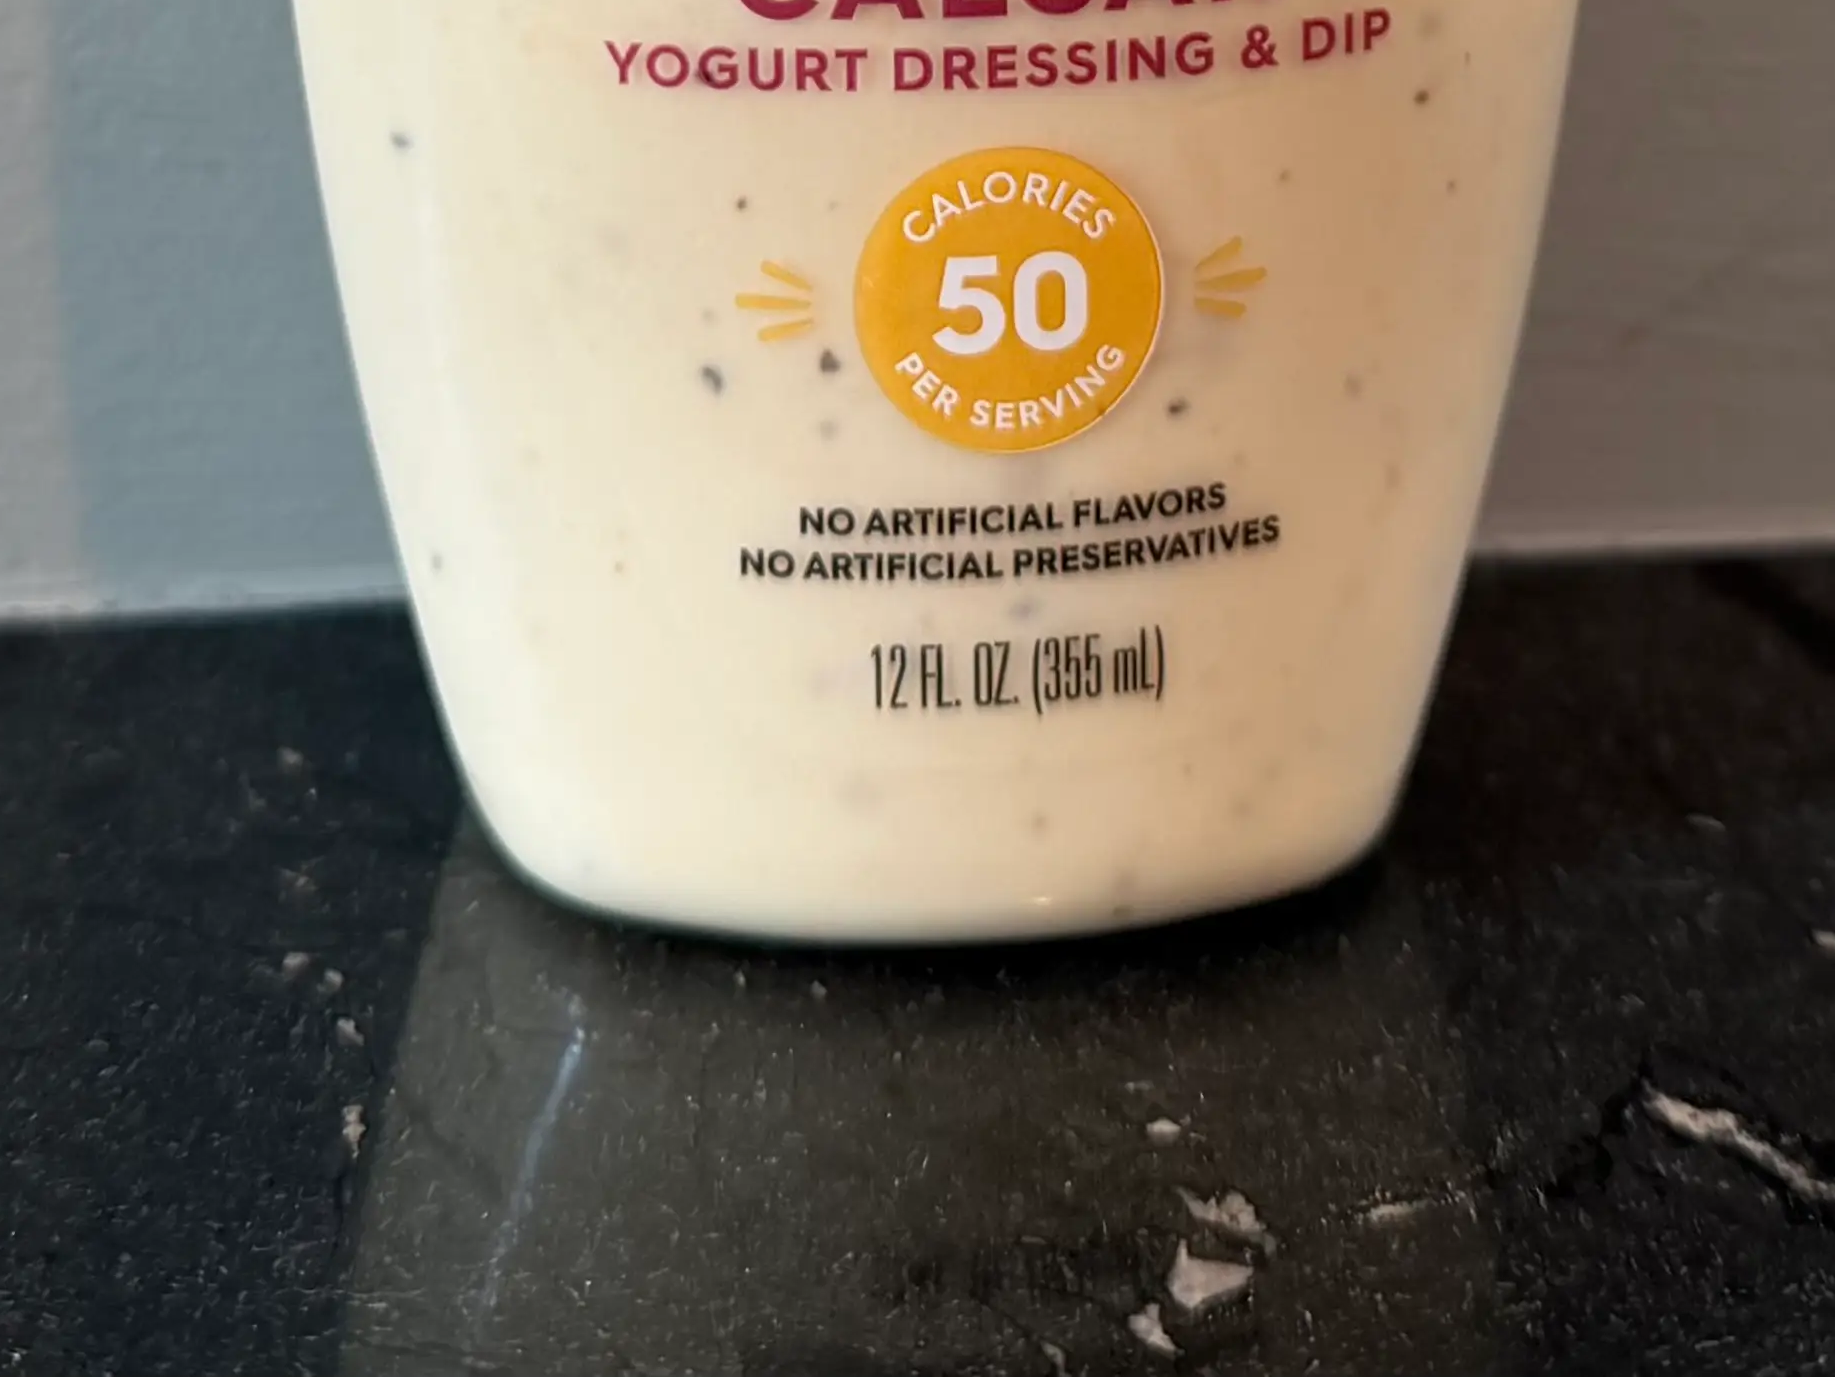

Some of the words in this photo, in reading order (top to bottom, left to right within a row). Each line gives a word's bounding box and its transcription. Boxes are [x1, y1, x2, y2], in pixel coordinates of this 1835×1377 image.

[604, 41, 868, 93] YOGURT
[894, 31, 1214, 92] DRESSING
[1241, 24, 1278, 67] &
[1301, 8, 1392, 60] DIP
[903, 170, 1116, 243] CALORIES
[931, 251, 1088, 355] 50
[895, 351, 959, 417] PER
[969, 343, 1127, 431] SERVING
[739, 547, 794, 578] NO
[804, 550, 1004, 580] ARTIFICIAL
[1012, 515, 1281, 578] PRESERVATIVES
[798, 506, 855, 537] NO
[863, 504, 1063, 537] ARTIFICIAL
[1073, 482, 1226, 528] FLAVORS
[870, 644, 908, 708] 12
[920, 644, 961, 708] FL.
[973, 641, 1019, 706] OZ.
[1032, 633, 1102, 715] (355
[1112, 625, 1165, 702] mL)
